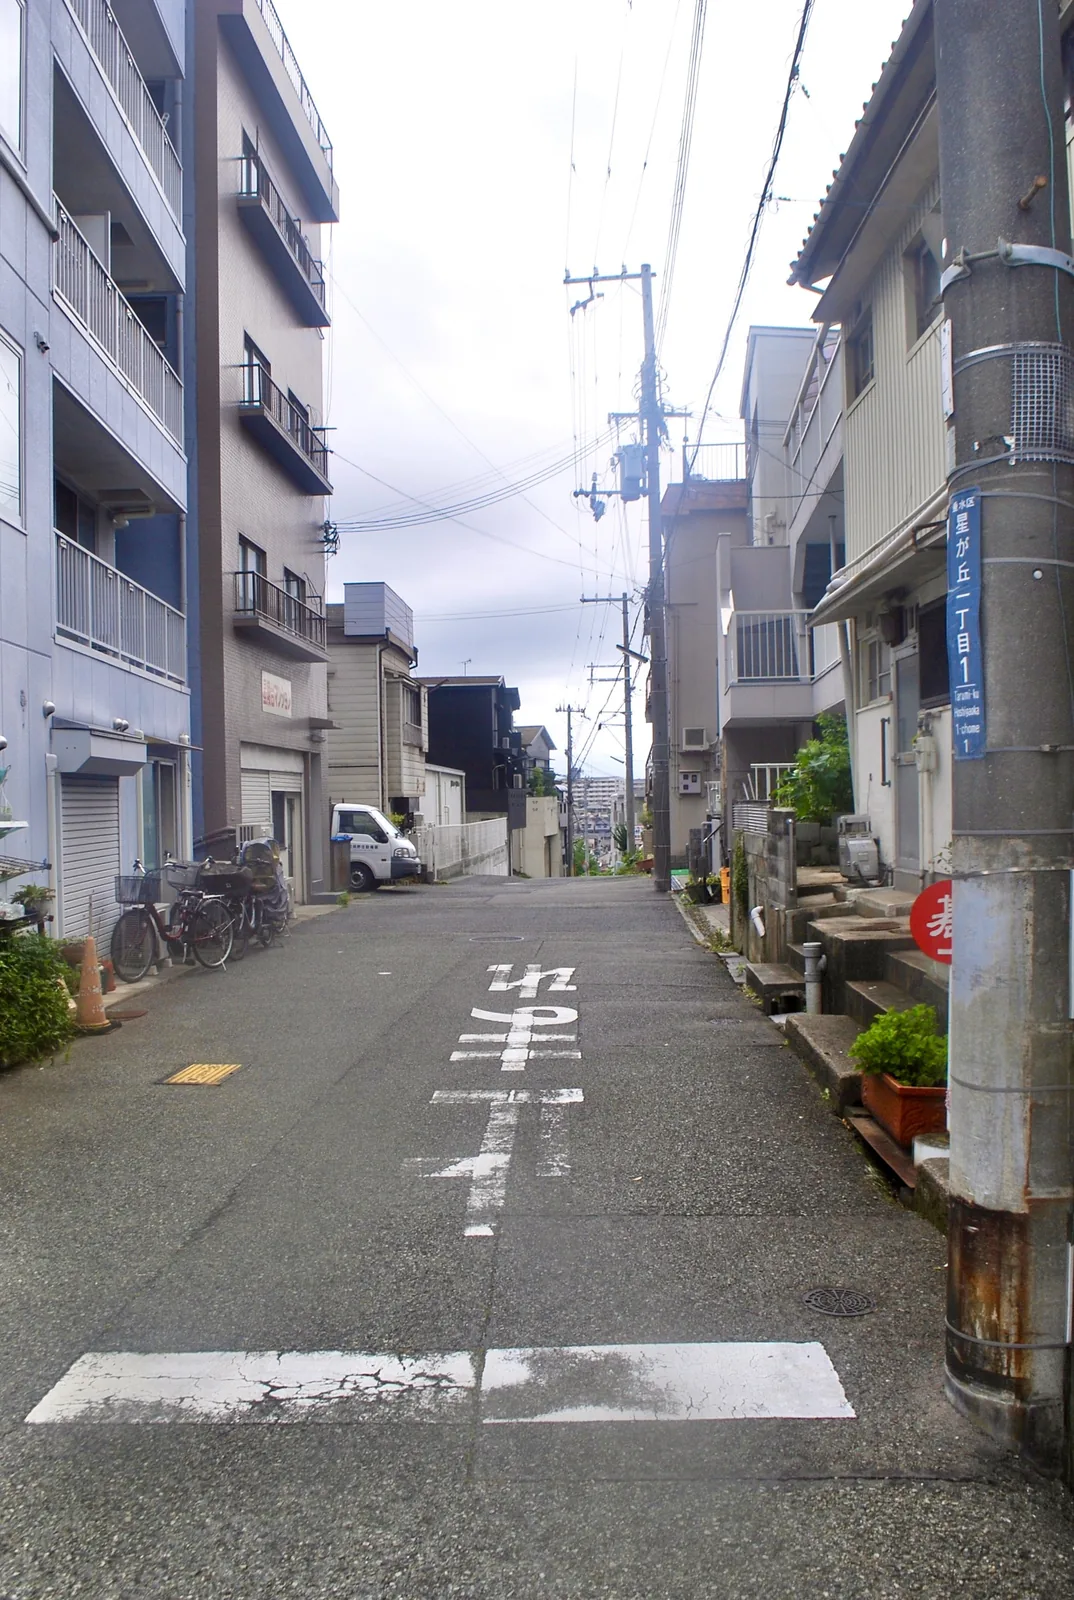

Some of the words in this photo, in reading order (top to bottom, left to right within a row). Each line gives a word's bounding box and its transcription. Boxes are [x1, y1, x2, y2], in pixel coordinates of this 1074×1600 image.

[954, 688, 980, 701] Tarumi-ku
[955, 722, 981, 736] 1-chome
[963, 738, 969, 753] 1
[402, 964, 585, 1237] 止まれ
